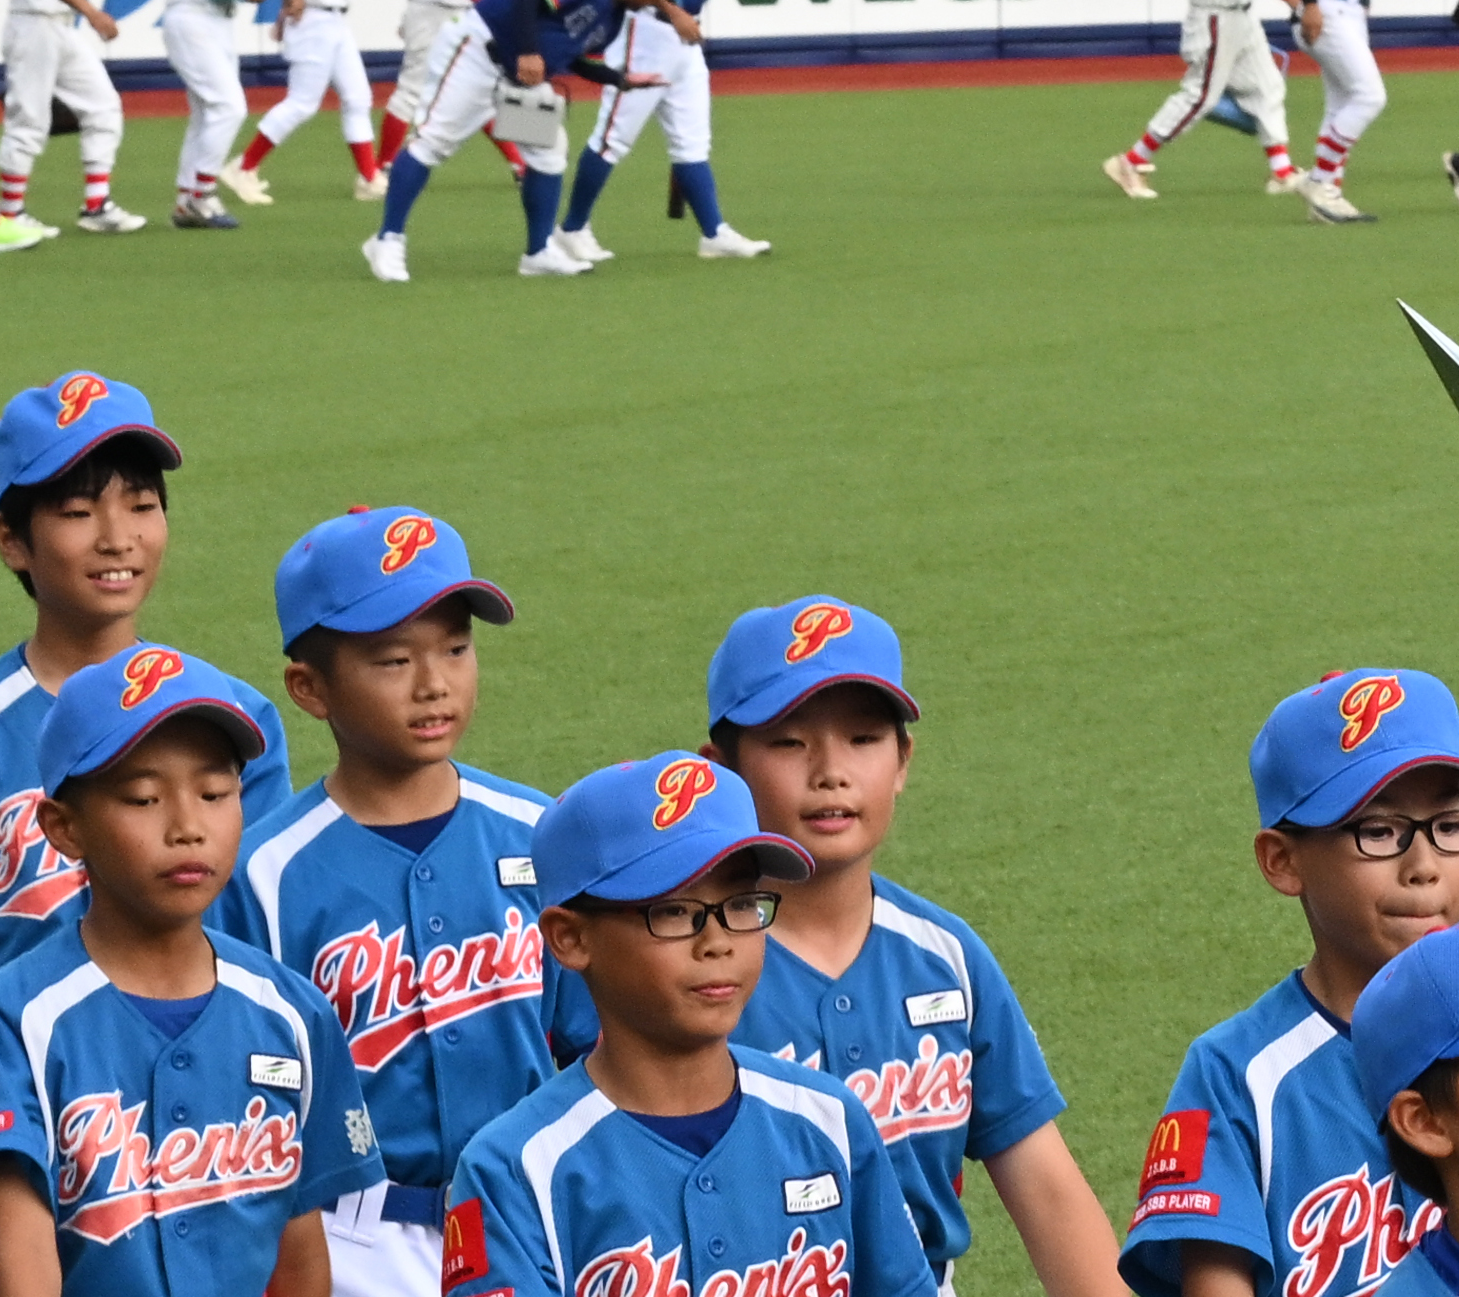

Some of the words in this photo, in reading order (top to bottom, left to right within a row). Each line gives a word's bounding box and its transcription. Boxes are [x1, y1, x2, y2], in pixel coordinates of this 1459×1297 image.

[57, 374, 109, 428] P
[380, 515, 436, 574] P
[785, 603, 853, 663] P
[120, 647, 184, 709] P
[1338, 675, 1405, 752] P
[652, 759, 717, 830] P
[772, 1034, 973, 1116] enix
[57, 1088, 302, 1204] Phenix
[1168, 1194, 1211, 1210] PLAYER
